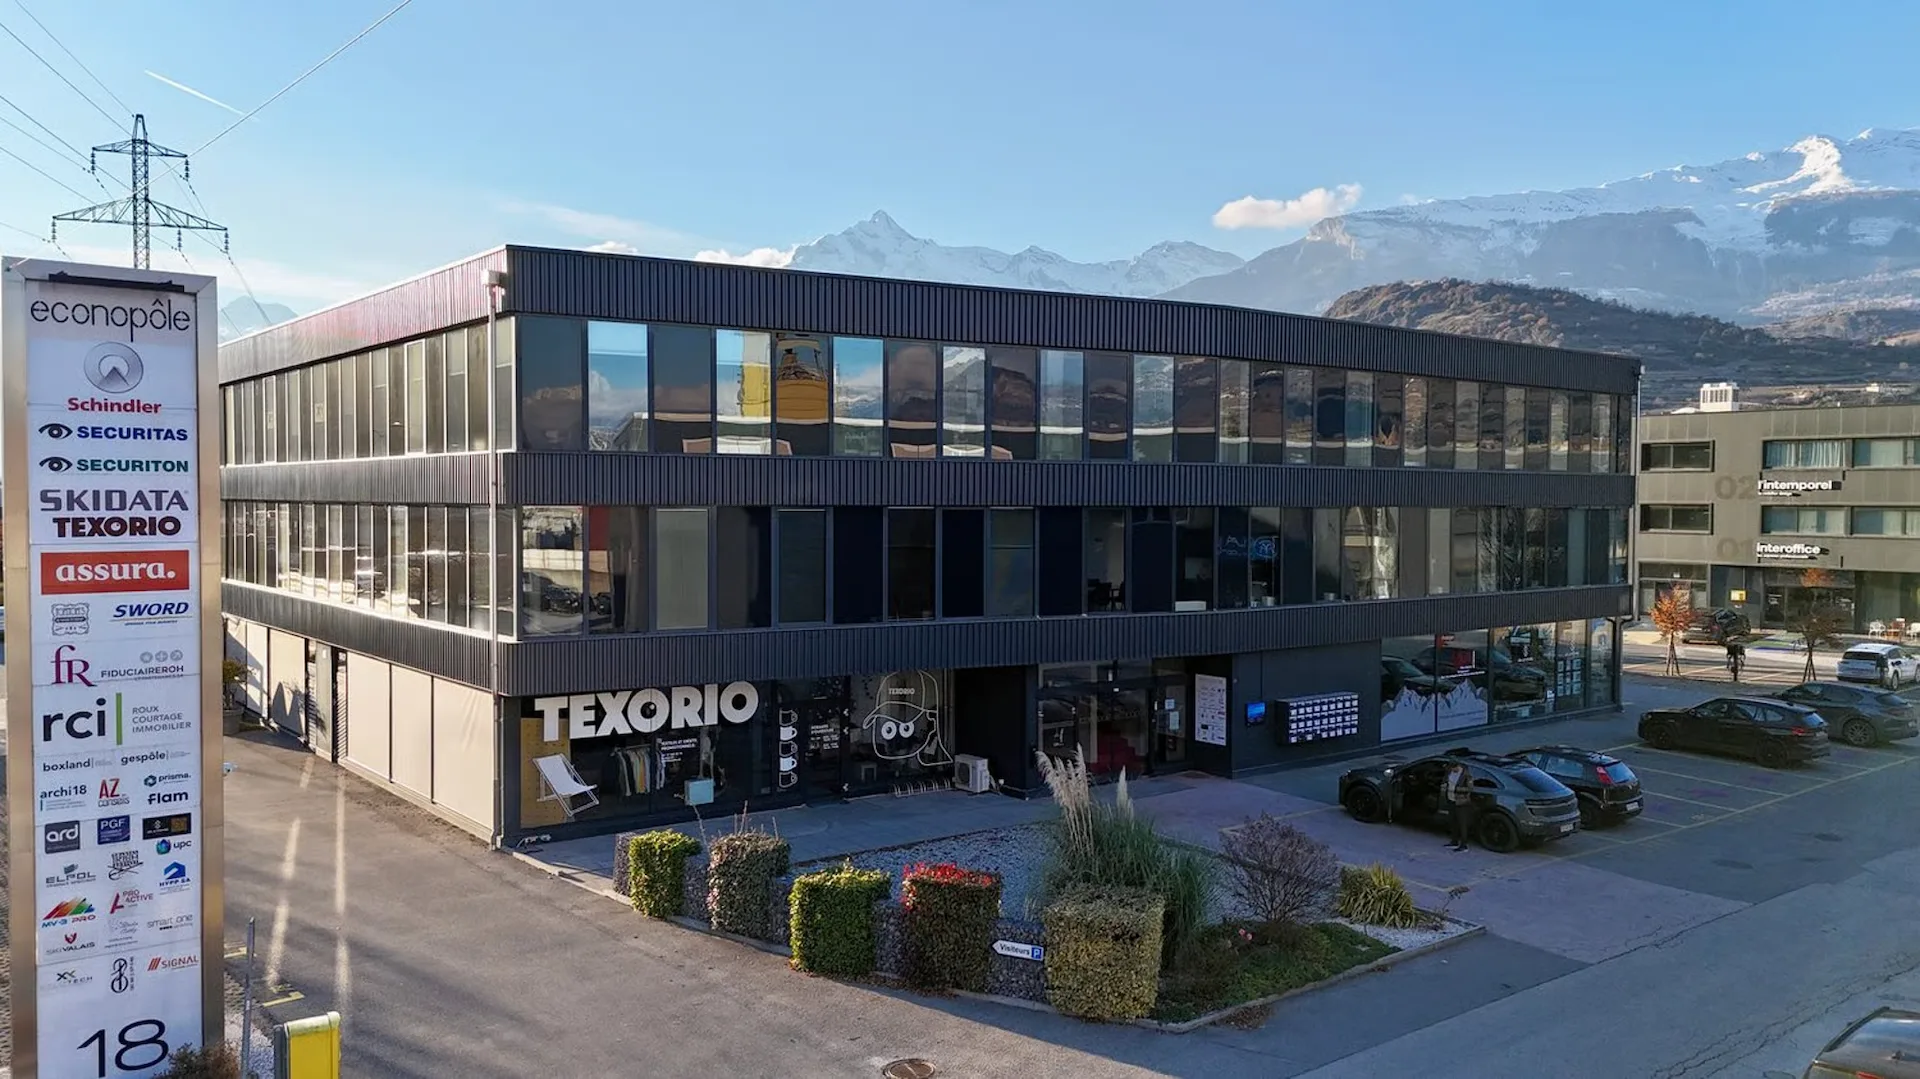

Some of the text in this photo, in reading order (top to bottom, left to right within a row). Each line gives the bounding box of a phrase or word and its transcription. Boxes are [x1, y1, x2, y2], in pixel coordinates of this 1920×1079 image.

[30, 299, 191, 342] econopôle
[67, 397, 162, 414] Schindler
[77, 425, 189, 441] SECURITAS
[76, 458, 189, 472] SECURITON
[40, 488, 190, 511] SKIDATA
[52, 516, 182, 538] TEXORIO
[54, 561, 176, 582] assura.
[113, 602, 189, 618] SWORD
[132, 706, 159, 715] ROUX
[534, 680, 759, 742] TEXORIO
[42, 697, 107, 742] rci
[132, 713, 183, 724] COURTAGE
[132, 722, 192, 733] IMMOBILIER
[42, 759, 91, 772] boxland
[121, 751, 166, 766] gespôle
[40, 785, 87, 799] archi18
[99, 778, 120, 799] AZ
[100, 819, 126, 830] PGF
[46, 824, 79, 842] ard
[173, 840, 192, 851] upc
[46, 872, 96, 884] ELPOL
[123, 889, 140, 897] PRO
[71, 914, 96, 923] PRO
[147, 919, 173, 929] smart
[175, 914, 193, 923] one
[1000, 944, 1030, 955] Visiteurs
[161, 955, 199, 969] SIGNAL
[77, 1019, 169, 1079] 18
